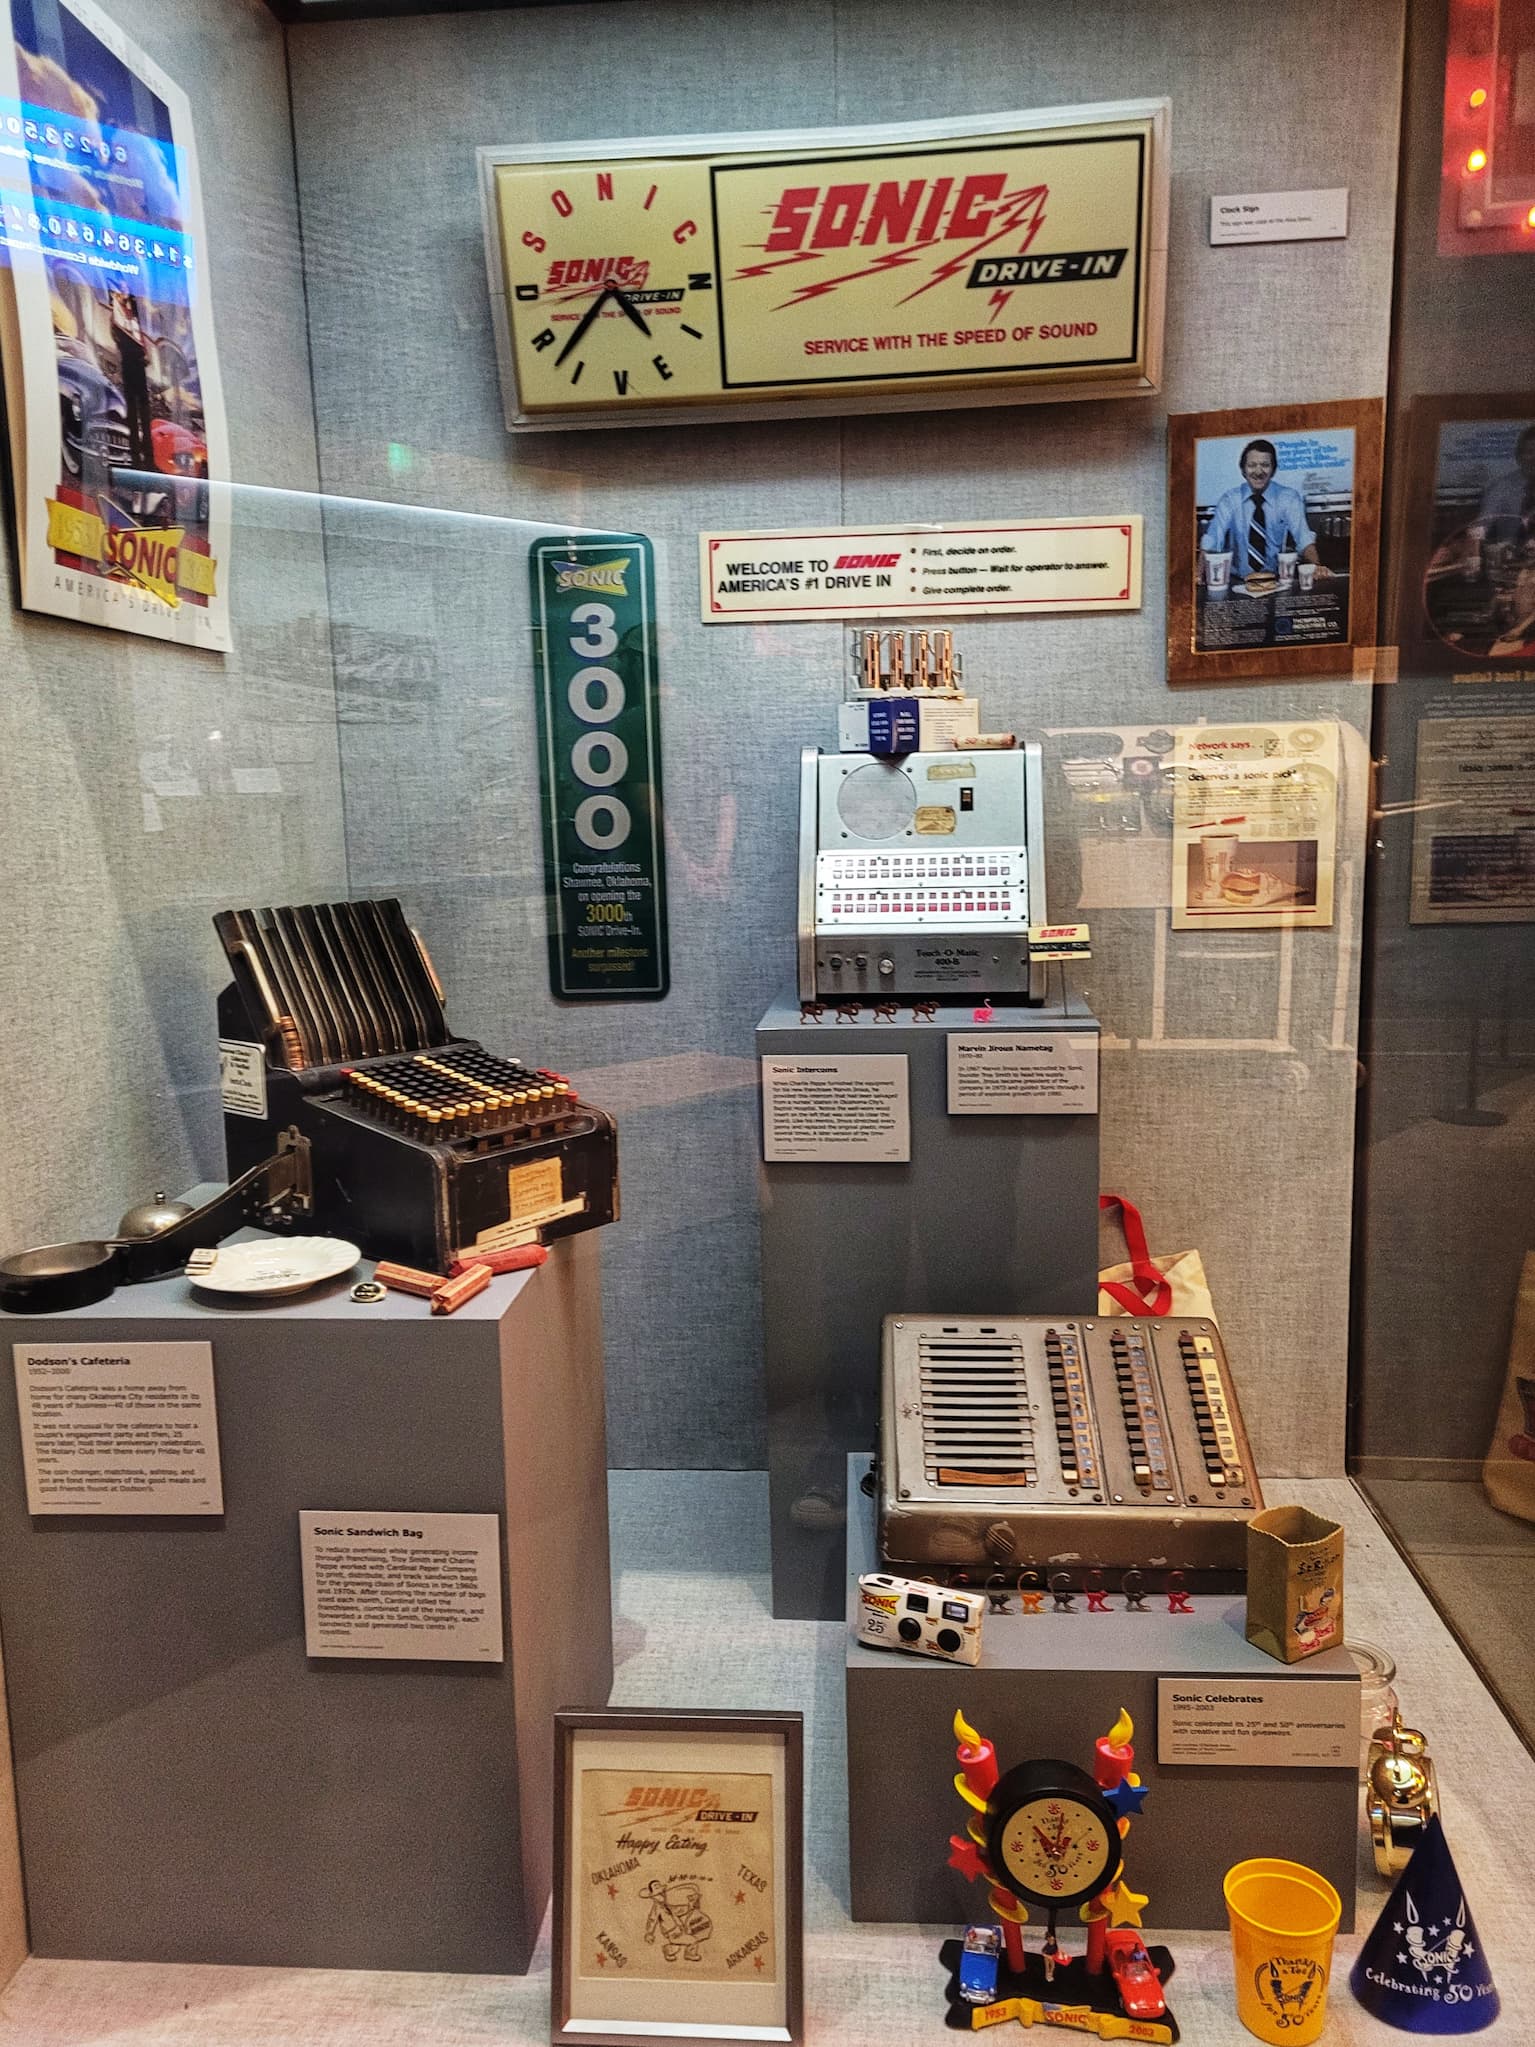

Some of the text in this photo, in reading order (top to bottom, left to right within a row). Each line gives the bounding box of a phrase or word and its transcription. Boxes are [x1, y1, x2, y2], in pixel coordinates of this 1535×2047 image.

[765, 173, 1009, 252] SONIC
[1243, 206, 1260, 214] Sign
[546, 256, 636, 284] SONIC
[972, 251, 1119, 286] DRIVE-IN
[655, 306, 681, 315] SOUND
[804, 321, 1098, 356] SERVICE WITH THE SPEED OF SOUND
[104, 523, 178, 585] SONIC
[946, 546, 976, 556] decide
[726, 553, 902, 576] WELCOME TO SONIC
[922, 567, 947, 576] Press
[948, 566, 978, 575] button
[990, 564, 1009, 573] Wait
[1010, 564, 1024, 572] for
[1025, 563, 1063, 573] operator
[1064, 562, 1074, 570] to
[560, 569, 625, 587] SONIC
[717, 574, 892, 594] AMERICA'S #1 DRIVE IN
[922, 586, 942, 595] Give
[943, 585, 985, 596] complete
[572, 861, 642, 876] Congratulations
[577, 889, 642, 903] on opening the
[577, 925, 604, 936] SONIC
[1040, 928, 1078, 939] SONIC
[571, 946, 649, 958] Another milestone
[1015, 1045, 1053, 1053] Nametag
[28, 1356, 130, 1366] Dodson's Cafeteria
[314, 1527, 424, 1539] Sonic Sandwich Bag
[862, 1594, 897, 1610] SONIC
[1172, 1694, 1264, 1704] Sonic Celebrates
[1172, 1720, 1195, 1728] Sonic
[1195, 1720, 1233, 1728] celebrated
[1235, 1720, 1244, 1728] its
[624, 1786, 709, 1808] SONIC
[616, 1831, 709, 1857] Happy Eating
[591, 1856, 641, 1886] OKLAHOMA
[736, 1863, 768, 1893] TEXAS
[595, 1930, 628, 1969] KANSAS
[725, 1931, 769, 1970] ARKANSAS
[1365, 1967, 1441, 2002] Celebrating
[1443, 1983, 1474, 2005] 50
[984, 2007, 1007, 2021] 1953
[1046, 2011, 1088, 2024] SONIC
